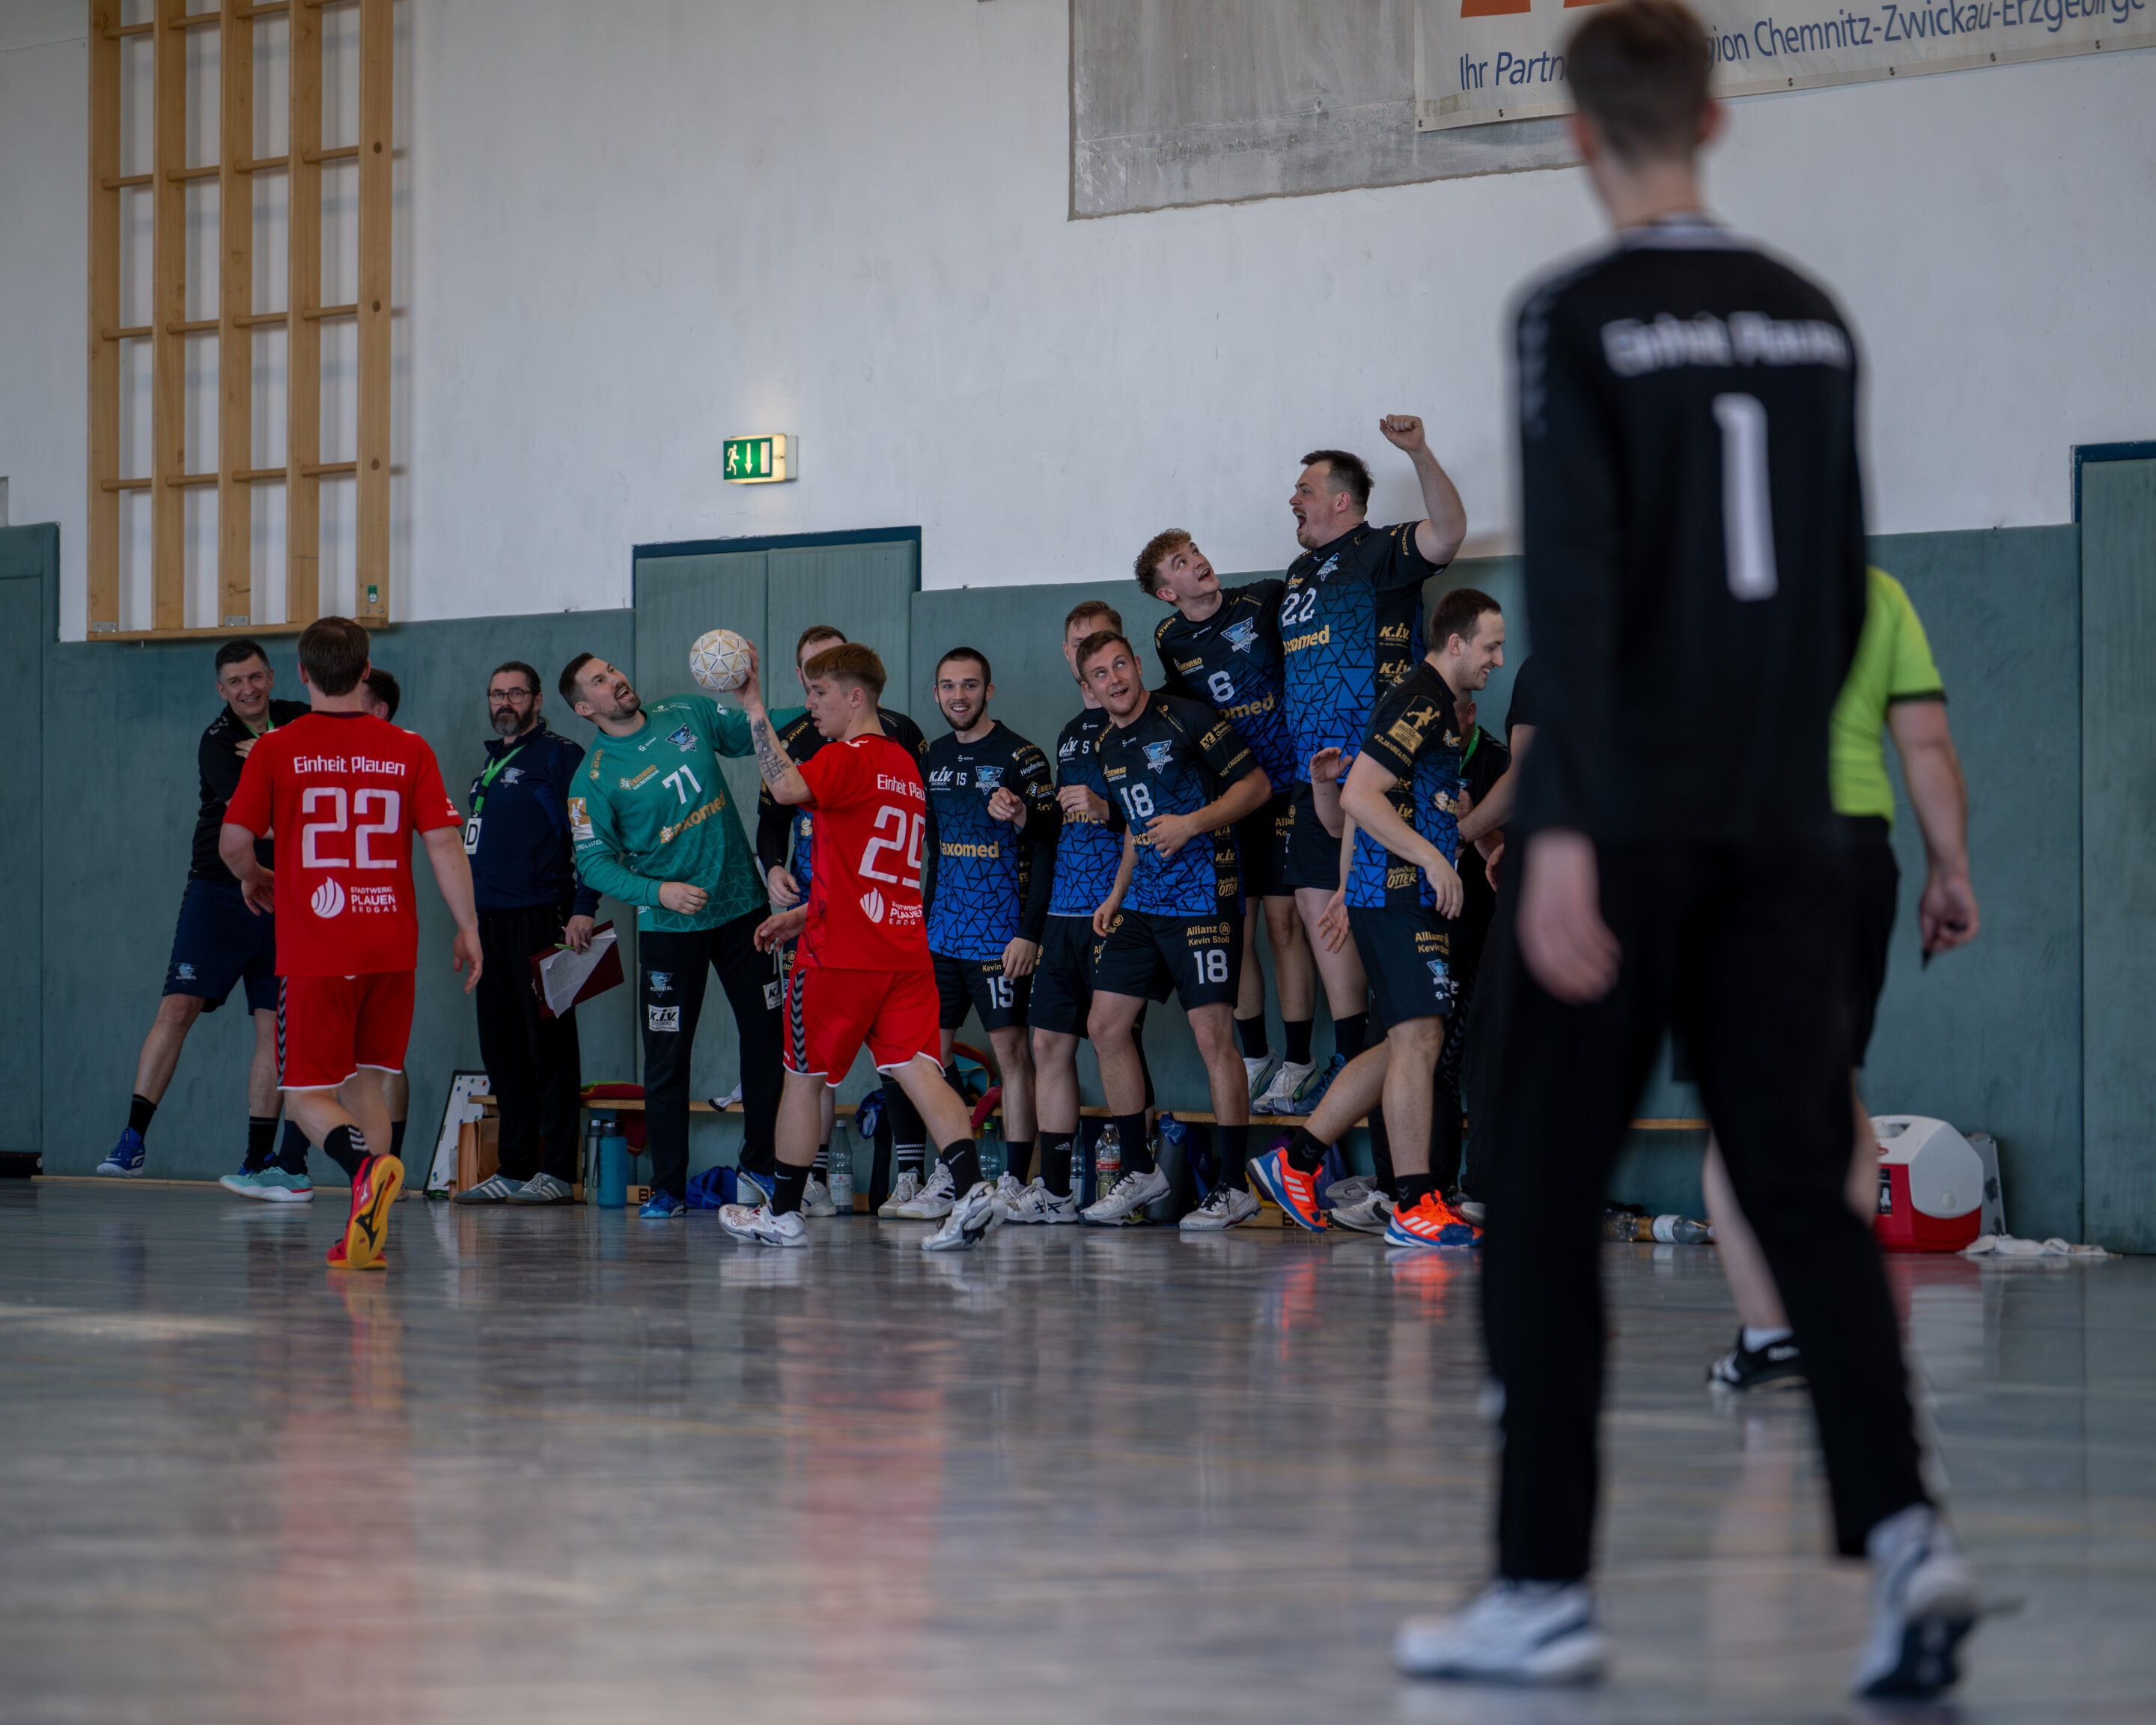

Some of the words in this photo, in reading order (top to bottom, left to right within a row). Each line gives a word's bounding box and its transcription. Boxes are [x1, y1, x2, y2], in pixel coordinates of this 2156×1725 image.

[1460, 53, 1487, 91] Ihr
[1496, 50, 1568, 87] Partn
[1706, 25, 1750, 73] gion
[1711, 392, 1779, 602] 1
[1282, 587, 1317, 627] 22
[1208, 671, 1235, 702] 6
[1218, 692, 1275, 721] omed
[293, 755, 347, 774] Einheit
[351, 755, 406, 776] Plauen
[661, 764, 702, 805] 71
[877, 773, 907, 796] Einheit
[956, 772, 968, 785] 15
[1120, 782, 1154, 820] 18
[302, 787, 401, 869] 22
[466, 824, 478, 845] D
[940, 839, 999, 858] axomed
[1219, 883, 1238, 897] OTTER
[1386, 871, 1417, 889] OTTER
[351, 894, 396, 906] PLAUEN
[352, 905, 398, 913] ERDGAS
[889, 917, 921, 926] ERDG
[1187, 925, 1217, 937] Allianz
[1188, 936, 1211, 946] Kevin
[1212, 934, 1230, 944] Stoll
[982, 963, 1002, 973] Kevin
[1193, 949, 1228, 985] 18
[987, 976, 1014, 1009] 15
